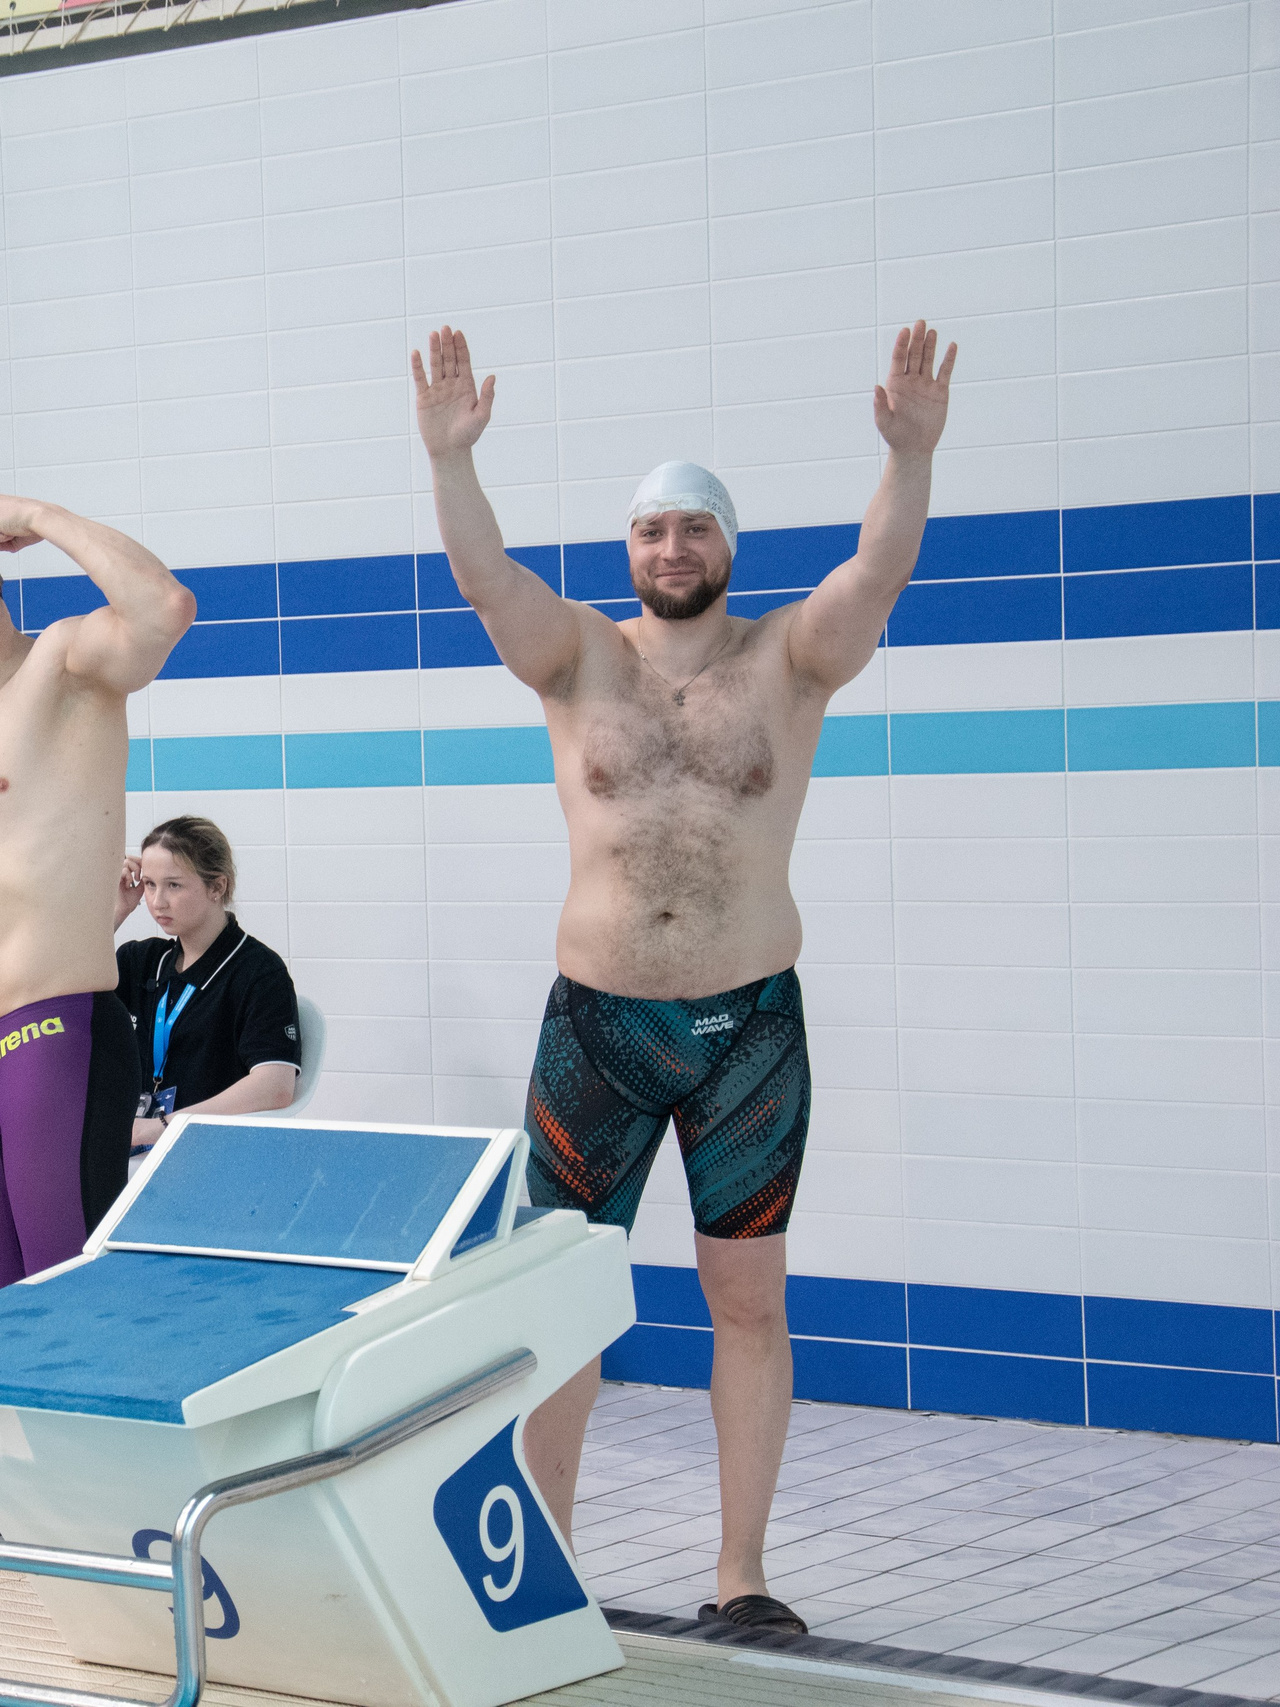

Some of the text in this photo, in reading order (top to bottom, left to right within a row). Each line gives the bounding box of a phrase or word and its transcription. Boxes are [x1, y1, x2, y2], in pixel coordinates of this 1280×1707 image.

[691, 1020, 734, 1036] WAVE
[695, 1014, 729, 1028] MAD
[479, 1484, 525, 1603] 9
